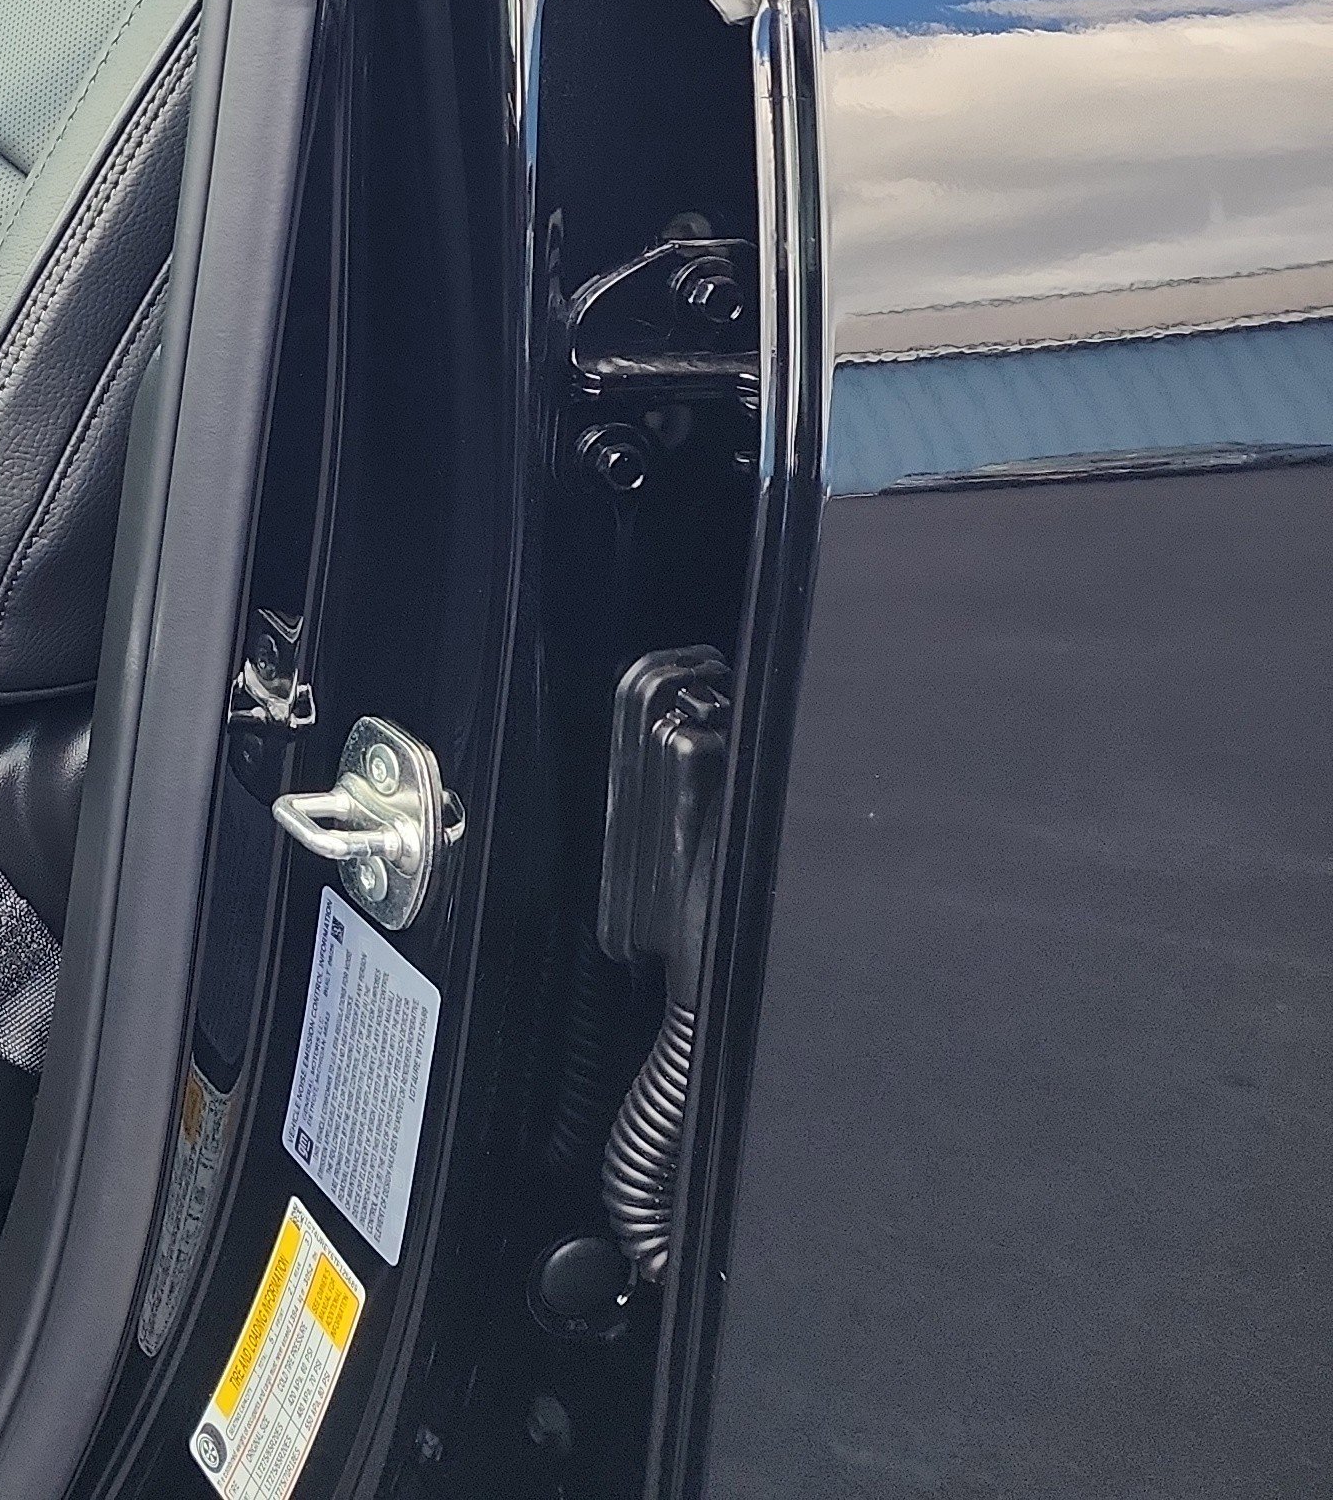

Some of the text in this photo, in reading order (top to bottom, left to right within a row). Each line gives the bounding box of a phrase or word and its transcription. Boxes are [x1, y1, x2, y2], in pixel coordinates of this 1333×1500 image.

[288, 899, 333, 1143] VEHICLE NOISE EMISSION CONTROL INFORMATION
[229, 1256, 289, 1390] TIRE AND LOADING INFORMATION
[311, 1298, 321, 1315] SEE
[318, 1277, 335, 1322] MANUAL FOR
[325, 1289, 342, 1328] ADDITIONAL
[330, 1293, 349, 1339] INFORMATION
[277, 1321, 308, 1393] COLD TIRE PRESSURE
[246, 1415, 270, 1463] ORIGINAL SIZE
